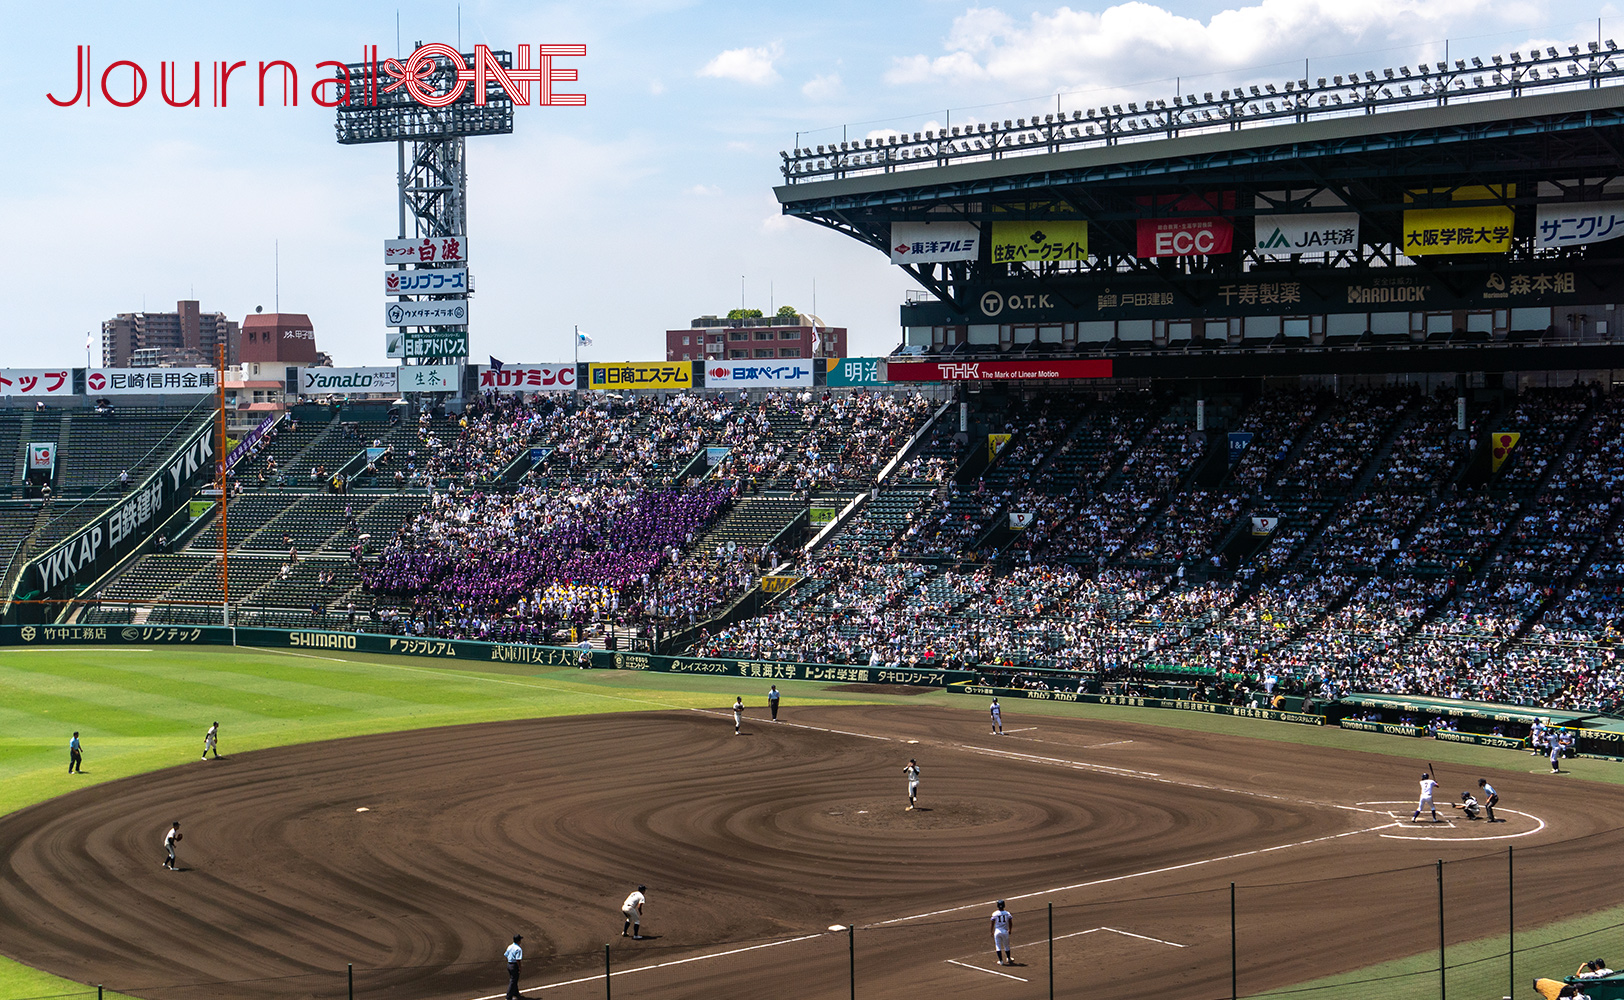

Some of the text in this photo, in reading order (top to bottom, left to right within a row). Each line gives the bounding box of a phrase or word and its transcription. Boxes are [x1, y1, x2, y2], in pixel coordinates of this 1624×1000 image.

[1155, 230, 1215, 255] ECC
[1295, 228, 1355, 247] JA共済
[1407, 226, 1510, 247] 大阪学院大学
[386, 247, 415, 256] さつま
[911, 240, 975, 254] 東洋アルミ
[994, 242, 1085, 262] 住友ベークライト
[400, 273, 464, 289] シノブフーズ
[1509, 272, 1575, 295] 森本組
[1008, 294, 1054, 309] O.T.K.
[1120, 292, 1174, 306] 戸田建設
[1218, 282, 1300, 305] 千寿製薬
[405, 308, 454, 317] ウメダチーズラボ
[414, 370, 441, 386] 生茶
[480, 367, 575, 387] オロナミンC
[607, 367, 689, 384] 日商エステム
[733, 366, 809, 380] 日本ペイント
[938, 363, 979, 379] THK
[994, 370, 1009, 378] Mark
[1010, 370, 1017, 378] of
[1018, 370, 1037, 378] Linear
[1038, 369, 1059, 378] Motion
[110, 372, 215, 389] 尼崎信用金庫
[305, 372, 372, 388] Yamato
[170, 428, 214, 491] YKK
[109, 475, 164, 549] 日鉄建材
[38, 527, 103, 593] YKK AP
[44, 627, 107, 640] 竹中工務店
[142, 628, 201, 641] リンテック
[290, 632, 356, 649] SHIMANO
[400, 640, 456, 656] フジプレアム
[491, 645, 571, 666] 武庫川女子大
[681, 662, 728, 673] レイズネクスト
[751, 663, 796, 679] 東海大学
[805, 667, 869, 682] トンボ学生服
[878, 671, 945, 684] タキロンシーアイ
[1027, 691, 1078, 702] オカムラ オカムラ
[1342, 721, 1363, 729] TOYOBO
[1383, 725, 1416, 736] KONAMI
[1437, 732, 1460, 742] TOYOBO
[1481, 737, 1519, 749] コナミグループ
